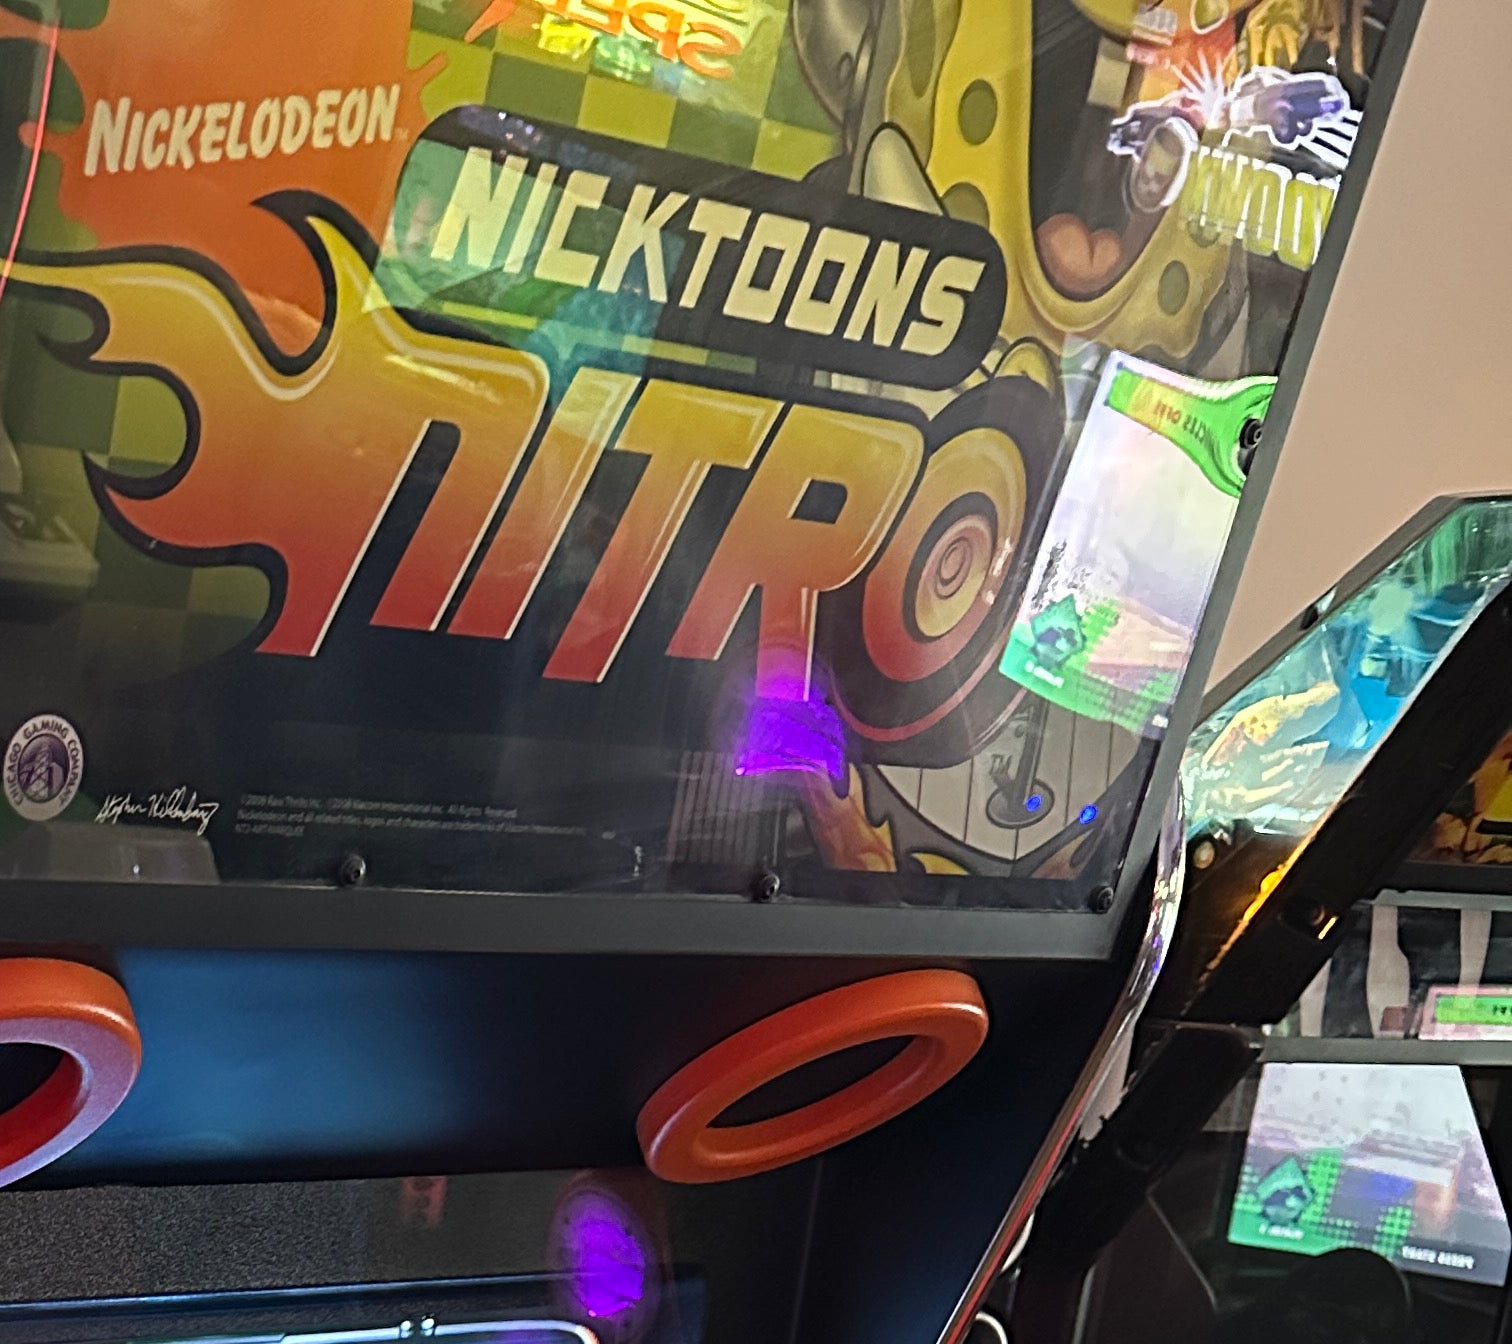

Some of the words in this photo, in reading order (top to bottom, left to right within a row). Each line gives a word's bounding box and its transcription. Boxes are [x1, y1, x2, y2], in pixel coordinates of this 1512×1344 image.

[84, 83, 400, 176] NICKELODEON
[430, 148, 985, 357] NICKTOONS
[68, 225, 1028, 702] NITRO
[23, 719, 69, 740] GAMING
